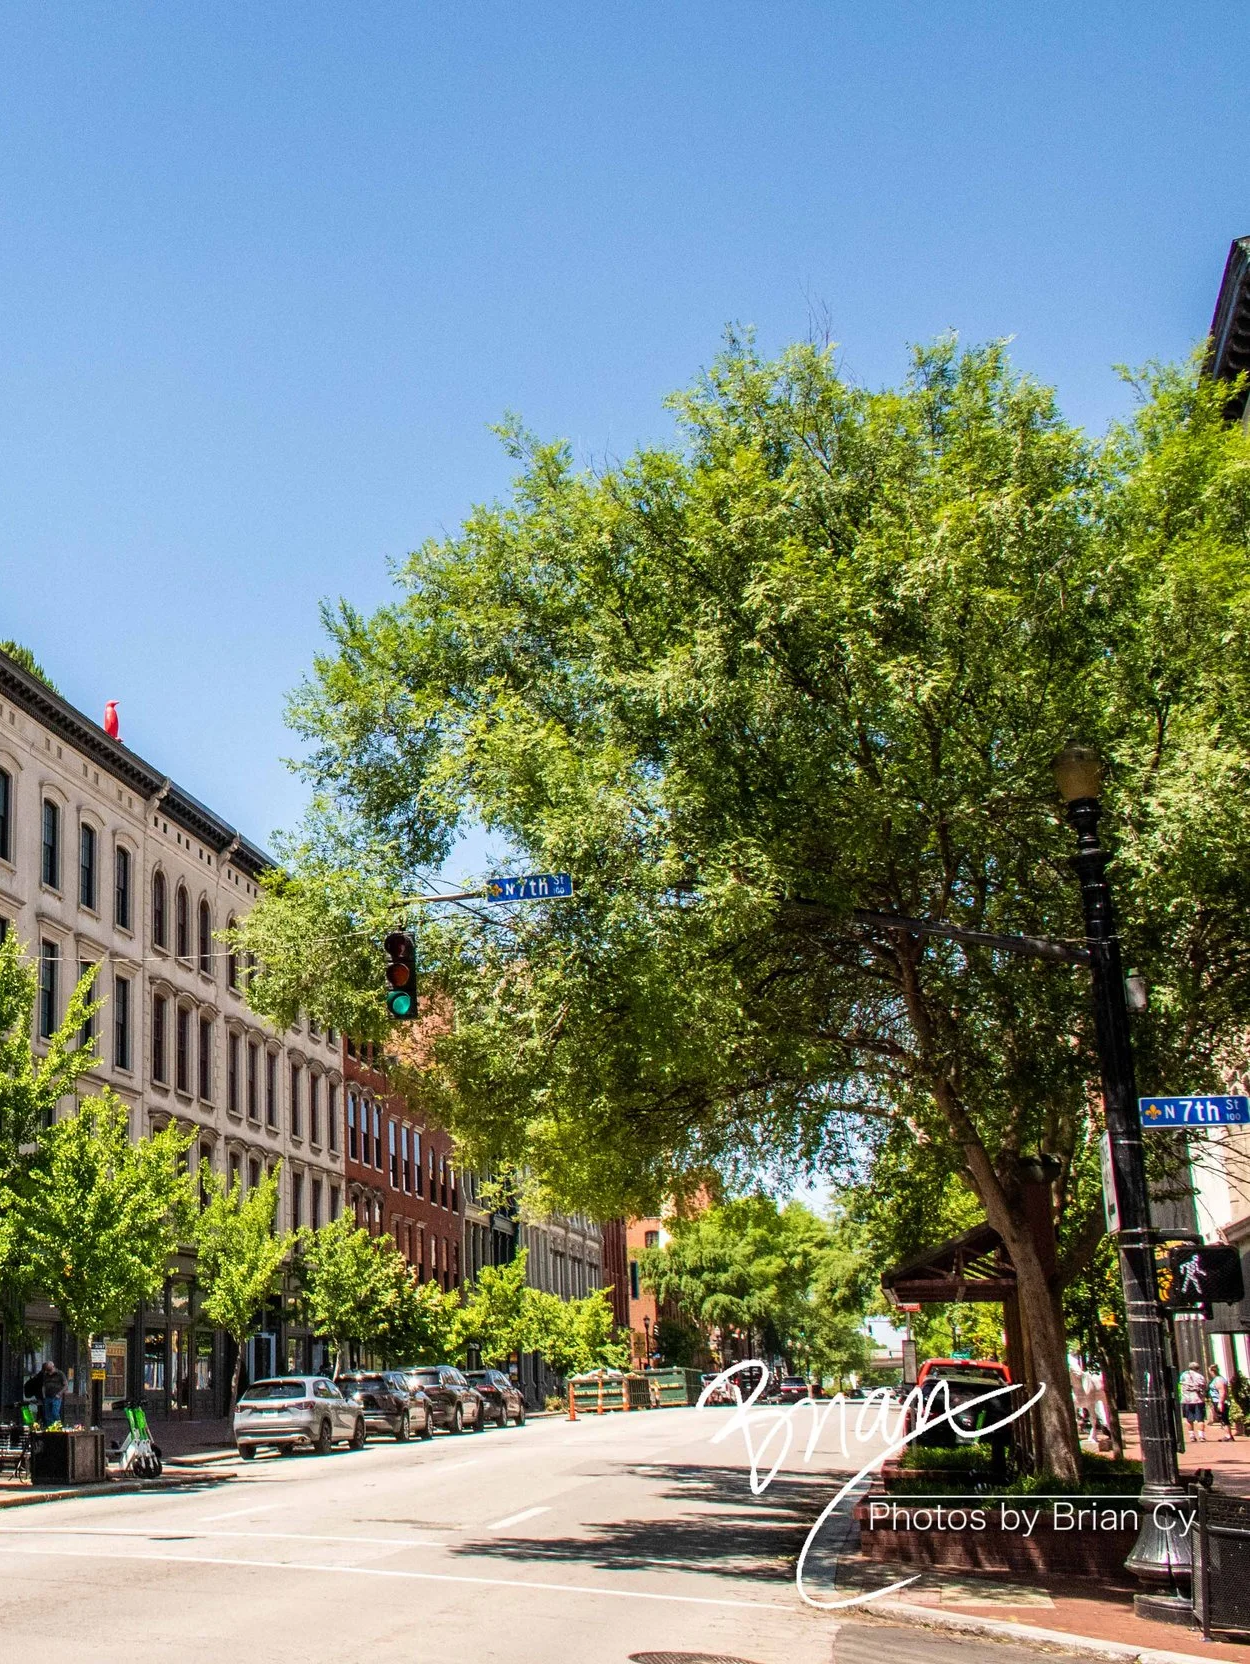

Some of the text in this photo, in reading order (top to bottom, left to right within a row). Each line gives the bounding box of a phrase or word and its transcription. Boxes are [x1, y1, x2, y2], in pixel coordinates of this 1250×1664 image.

[505, 883, 516, 896] N
[1164, 1099, 1239, 1122] N 7th St
[1226, 1113, 1241, 1121] 100
